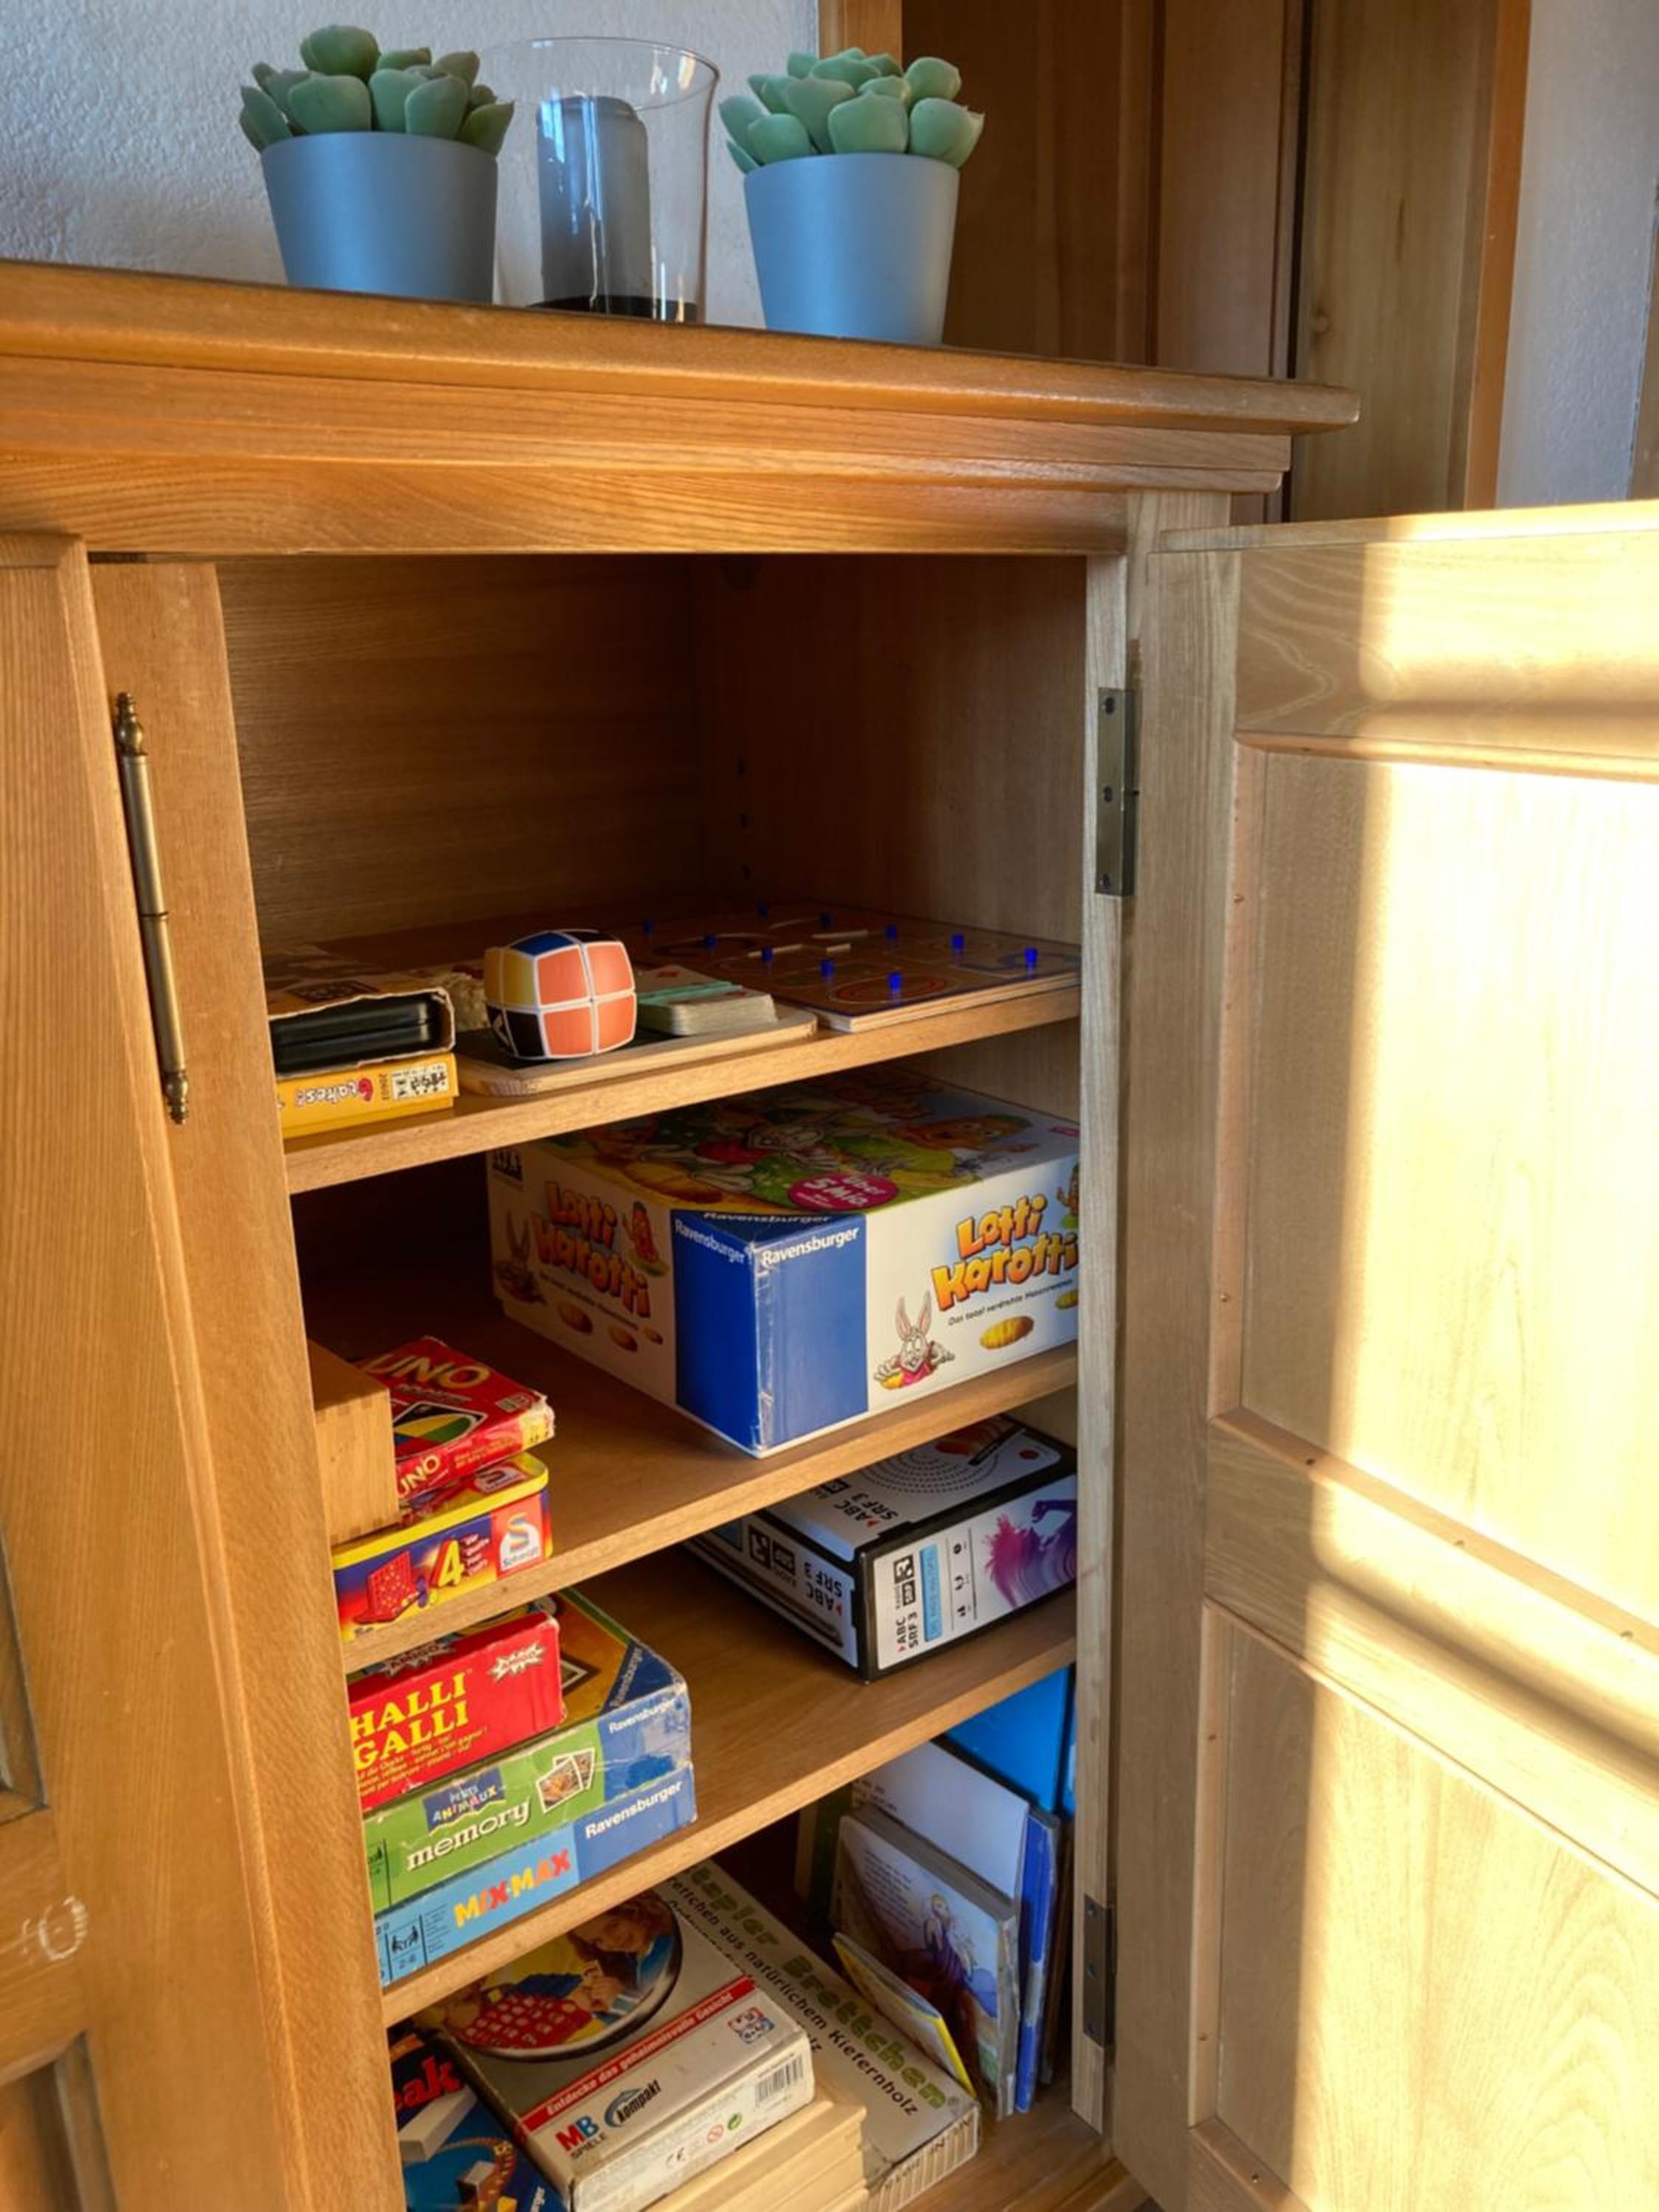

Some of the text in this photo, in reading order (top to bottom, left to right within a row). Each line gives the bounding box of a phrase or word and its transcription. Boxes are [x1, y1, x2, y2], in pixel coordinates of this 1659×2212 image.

[674, 1219, 745, 1264] Ravensburger
[761, 1226, 860, 1267] Ravensburger
[956, 1193, 1048, 1260] Lotti
[931, 1231, 1079, 1312] Karotti
[833, 1500, 869, 1522] ABC
[434, 1538, 468, 1587] 4
[816, 1570, 843, 1598] SRF
[806, 1581, 834, 1612] ABC
[897, 1616, 907, 1644] ABC
[908, 1623, 919, 1649] SRF
[350, 1672, 467, 1742] HALLI
[352, 1700, 470, 1770] GALLI
[406, 1796, 532, 1871] memory
[585, 1780, 684, 1840] Ravensburger
[720, 1925, 746, 1950] aus
[744, 1950, 827, 2030] natürlichem
[827, 2029, 919, 2116] Kiefernholz
[781, 1955, 947, 2110] Brettchen
[555, 2115, 599, 2152] MB
